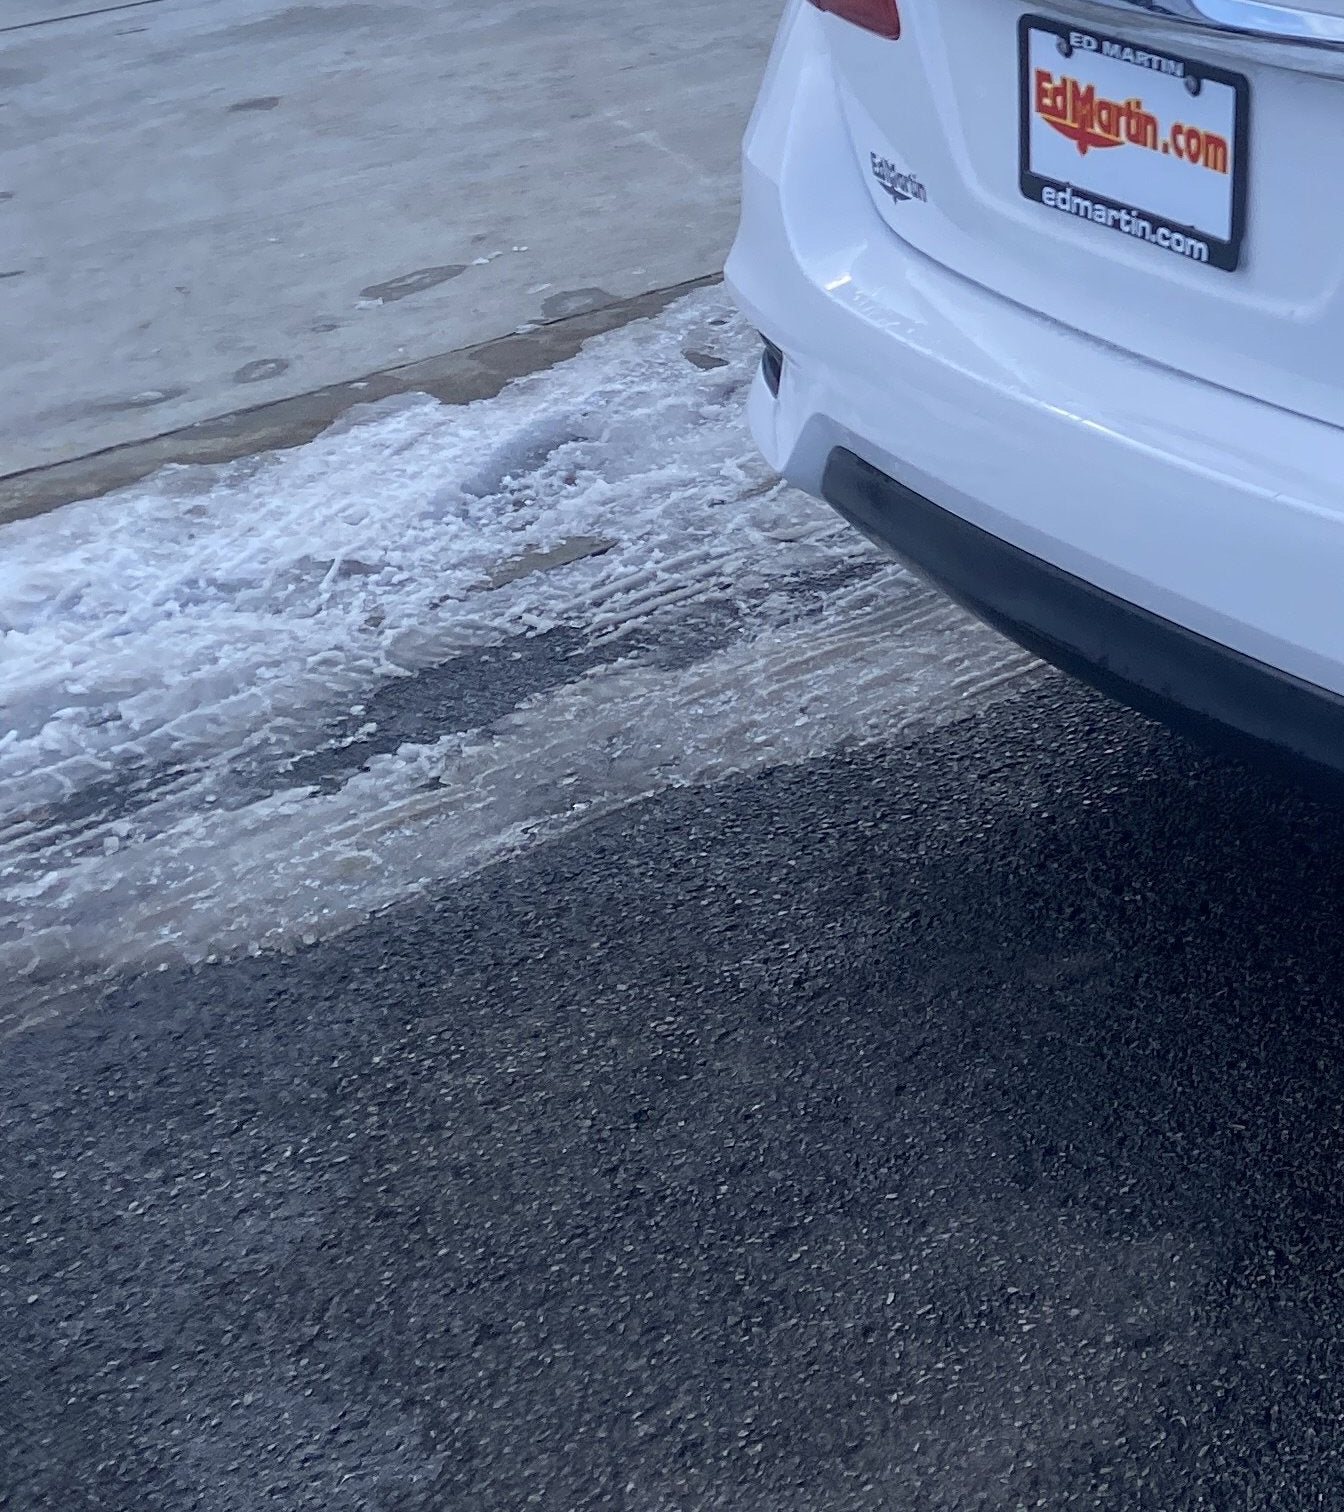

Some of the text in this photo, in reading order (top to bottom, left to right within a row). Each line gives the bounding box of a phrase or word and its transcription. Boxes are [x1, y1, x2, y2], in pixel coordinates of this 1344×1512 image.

[1069, 32, 1185, 78] ED MARTIN
[870, 151, 928, 203] EdMartin
[1042, 185, 1209, 263] edmartin.com
